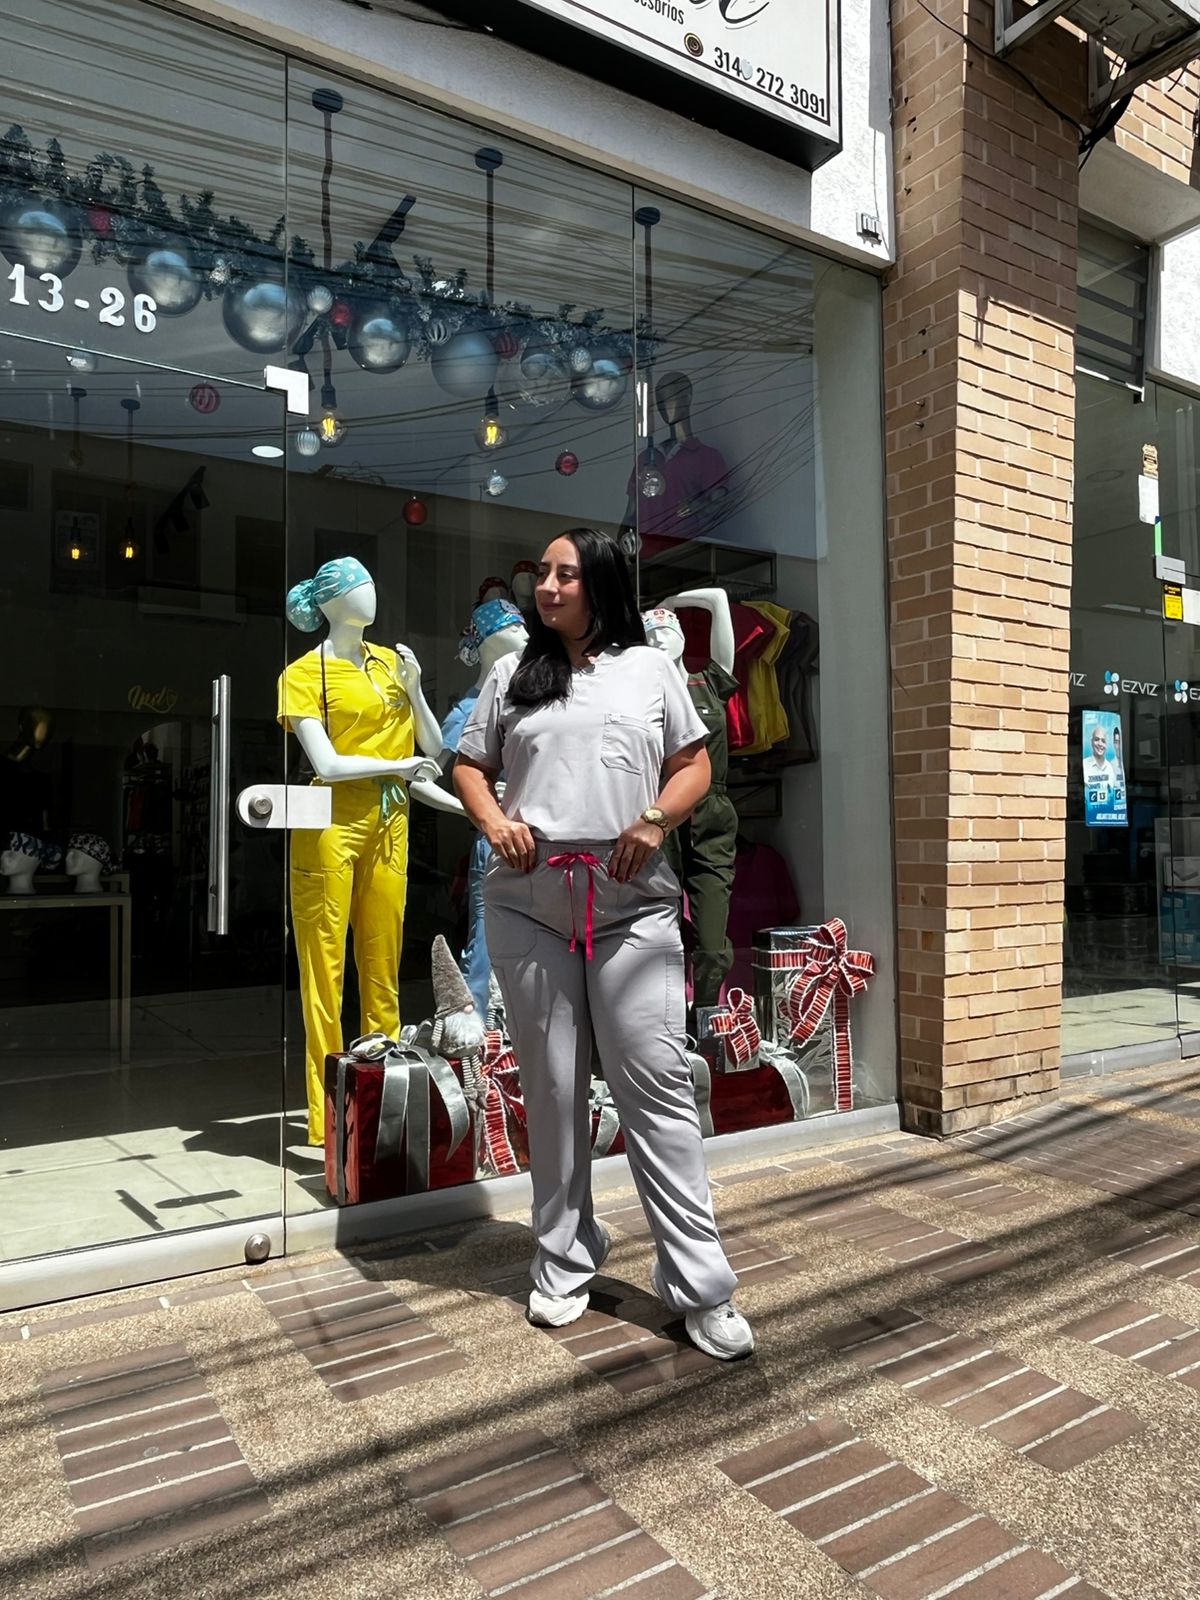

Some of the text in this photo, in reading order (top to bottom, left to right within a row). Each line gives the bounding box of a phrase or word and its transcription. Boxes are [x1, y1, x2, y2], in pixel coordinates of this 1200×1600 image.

[713, 46, 825, 118] 314 272 3091
[8, 264, 157, 333] 13-26
[1121, 679, 1159, 697] EZVIZ
